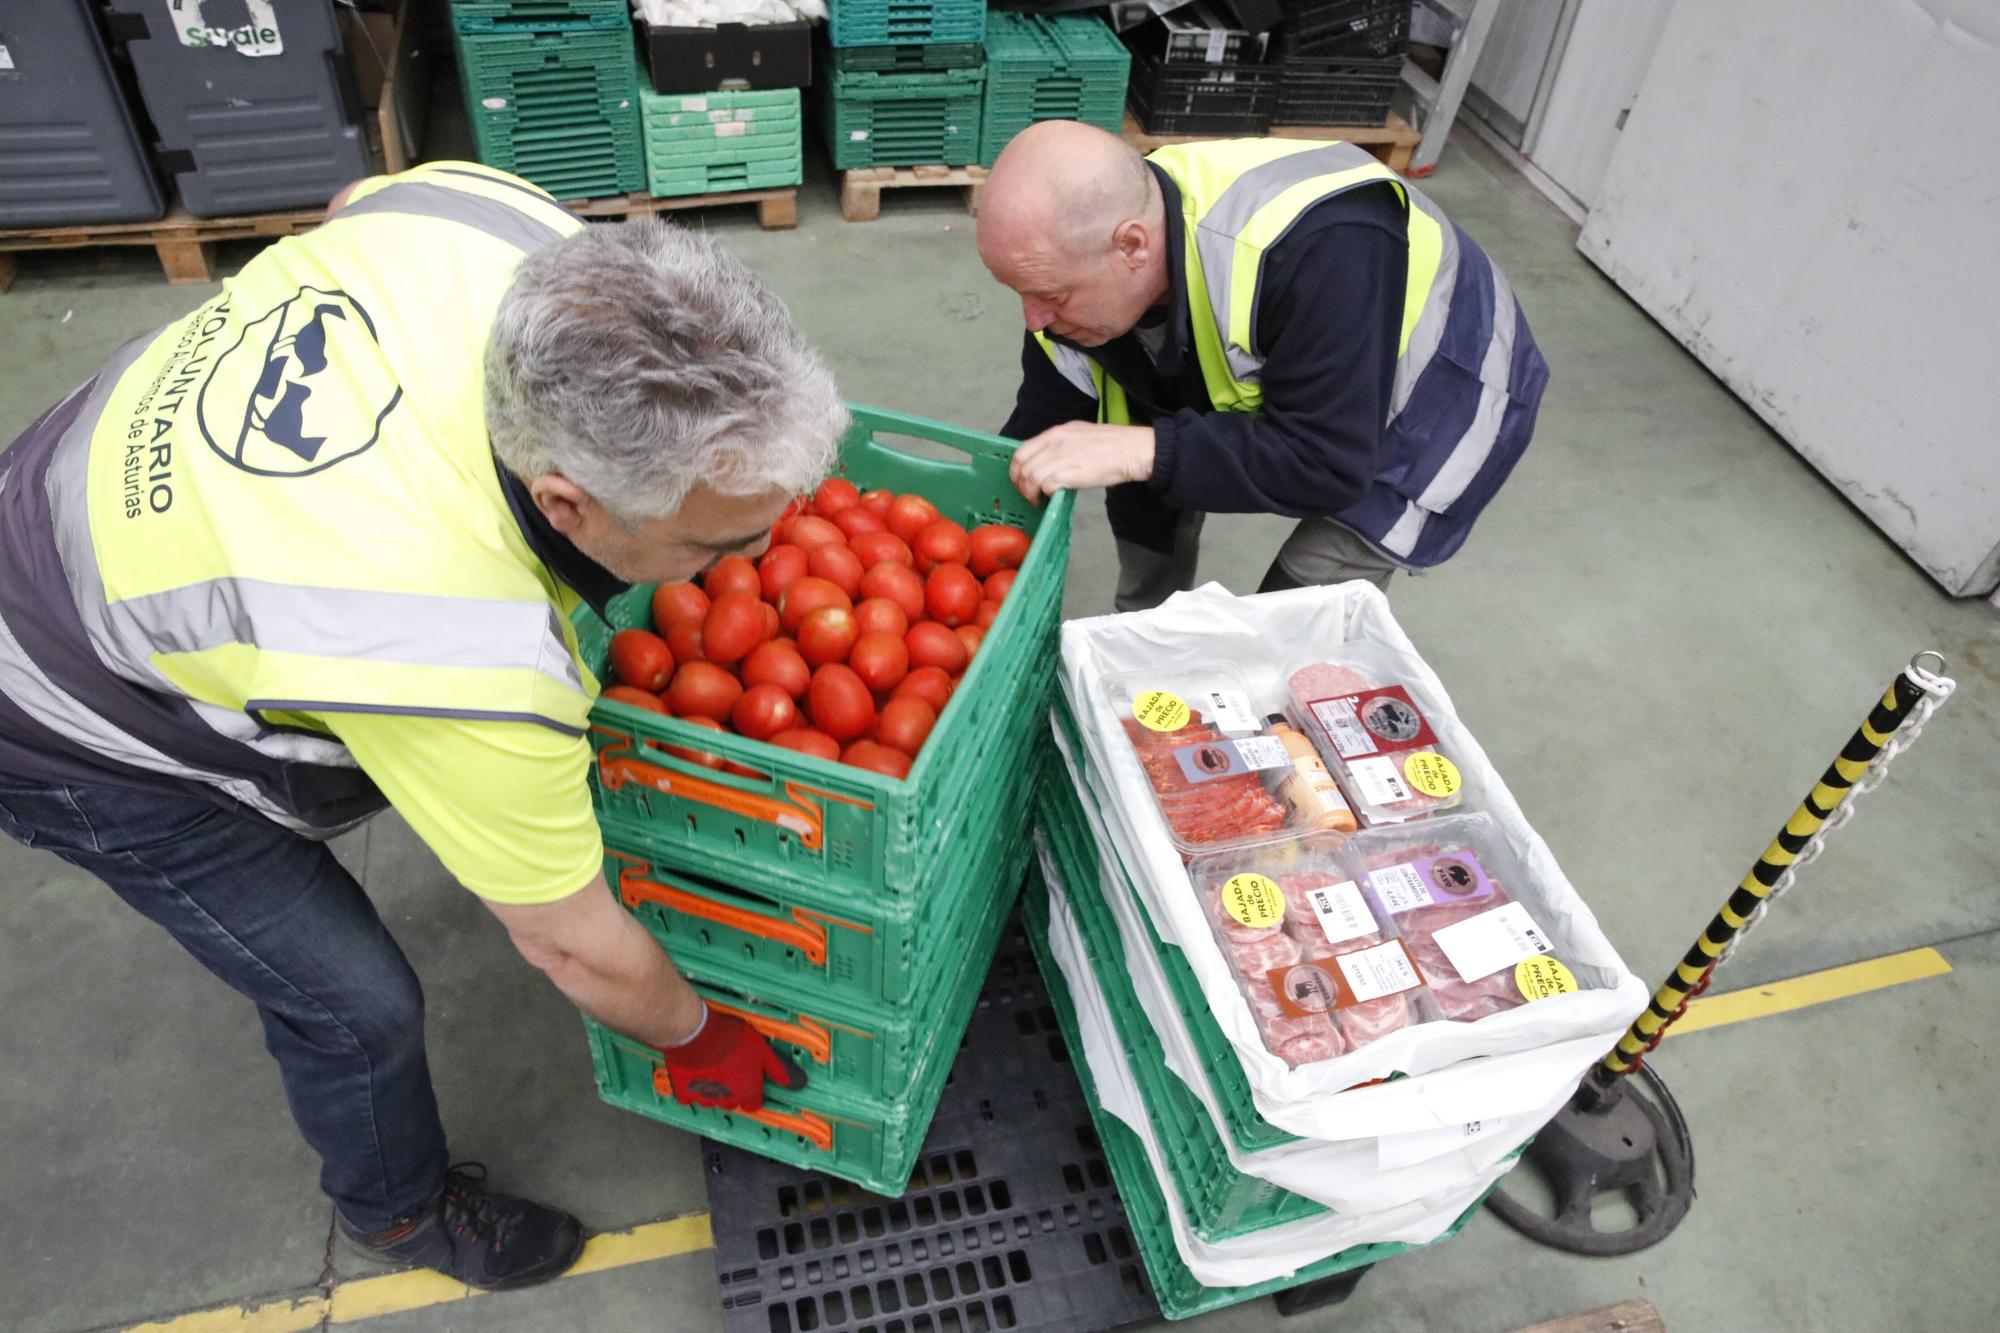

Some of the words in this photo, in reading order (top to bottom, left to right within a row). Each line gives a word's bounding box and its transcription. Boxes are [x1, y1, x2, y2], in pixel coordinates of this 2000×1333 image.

[149, 292, 232, 513] VOLUNTARIO
[127, 417, 149, 439] de
[123, 444, 146, 519] Asturias
[1138, 692, 1164, 720] BAJADA
[1155, 699, 1177, 725] PRECIO
[1419, 759, 1436, 791] PRECIO
[1431, 769, 1439, 779] de
[1434, 756, 1454, 793] BAJADA
[1436, 868, 1452, 888] PAVO
[1231, 879, 1251, 923] BAJADA
[1246, 894, 1255, 905] de
[1250, 880, 1269, 918] PRECIO
[1531, 964, 1549, 998] PRECI
[1545, 978, 1554, 989] de
